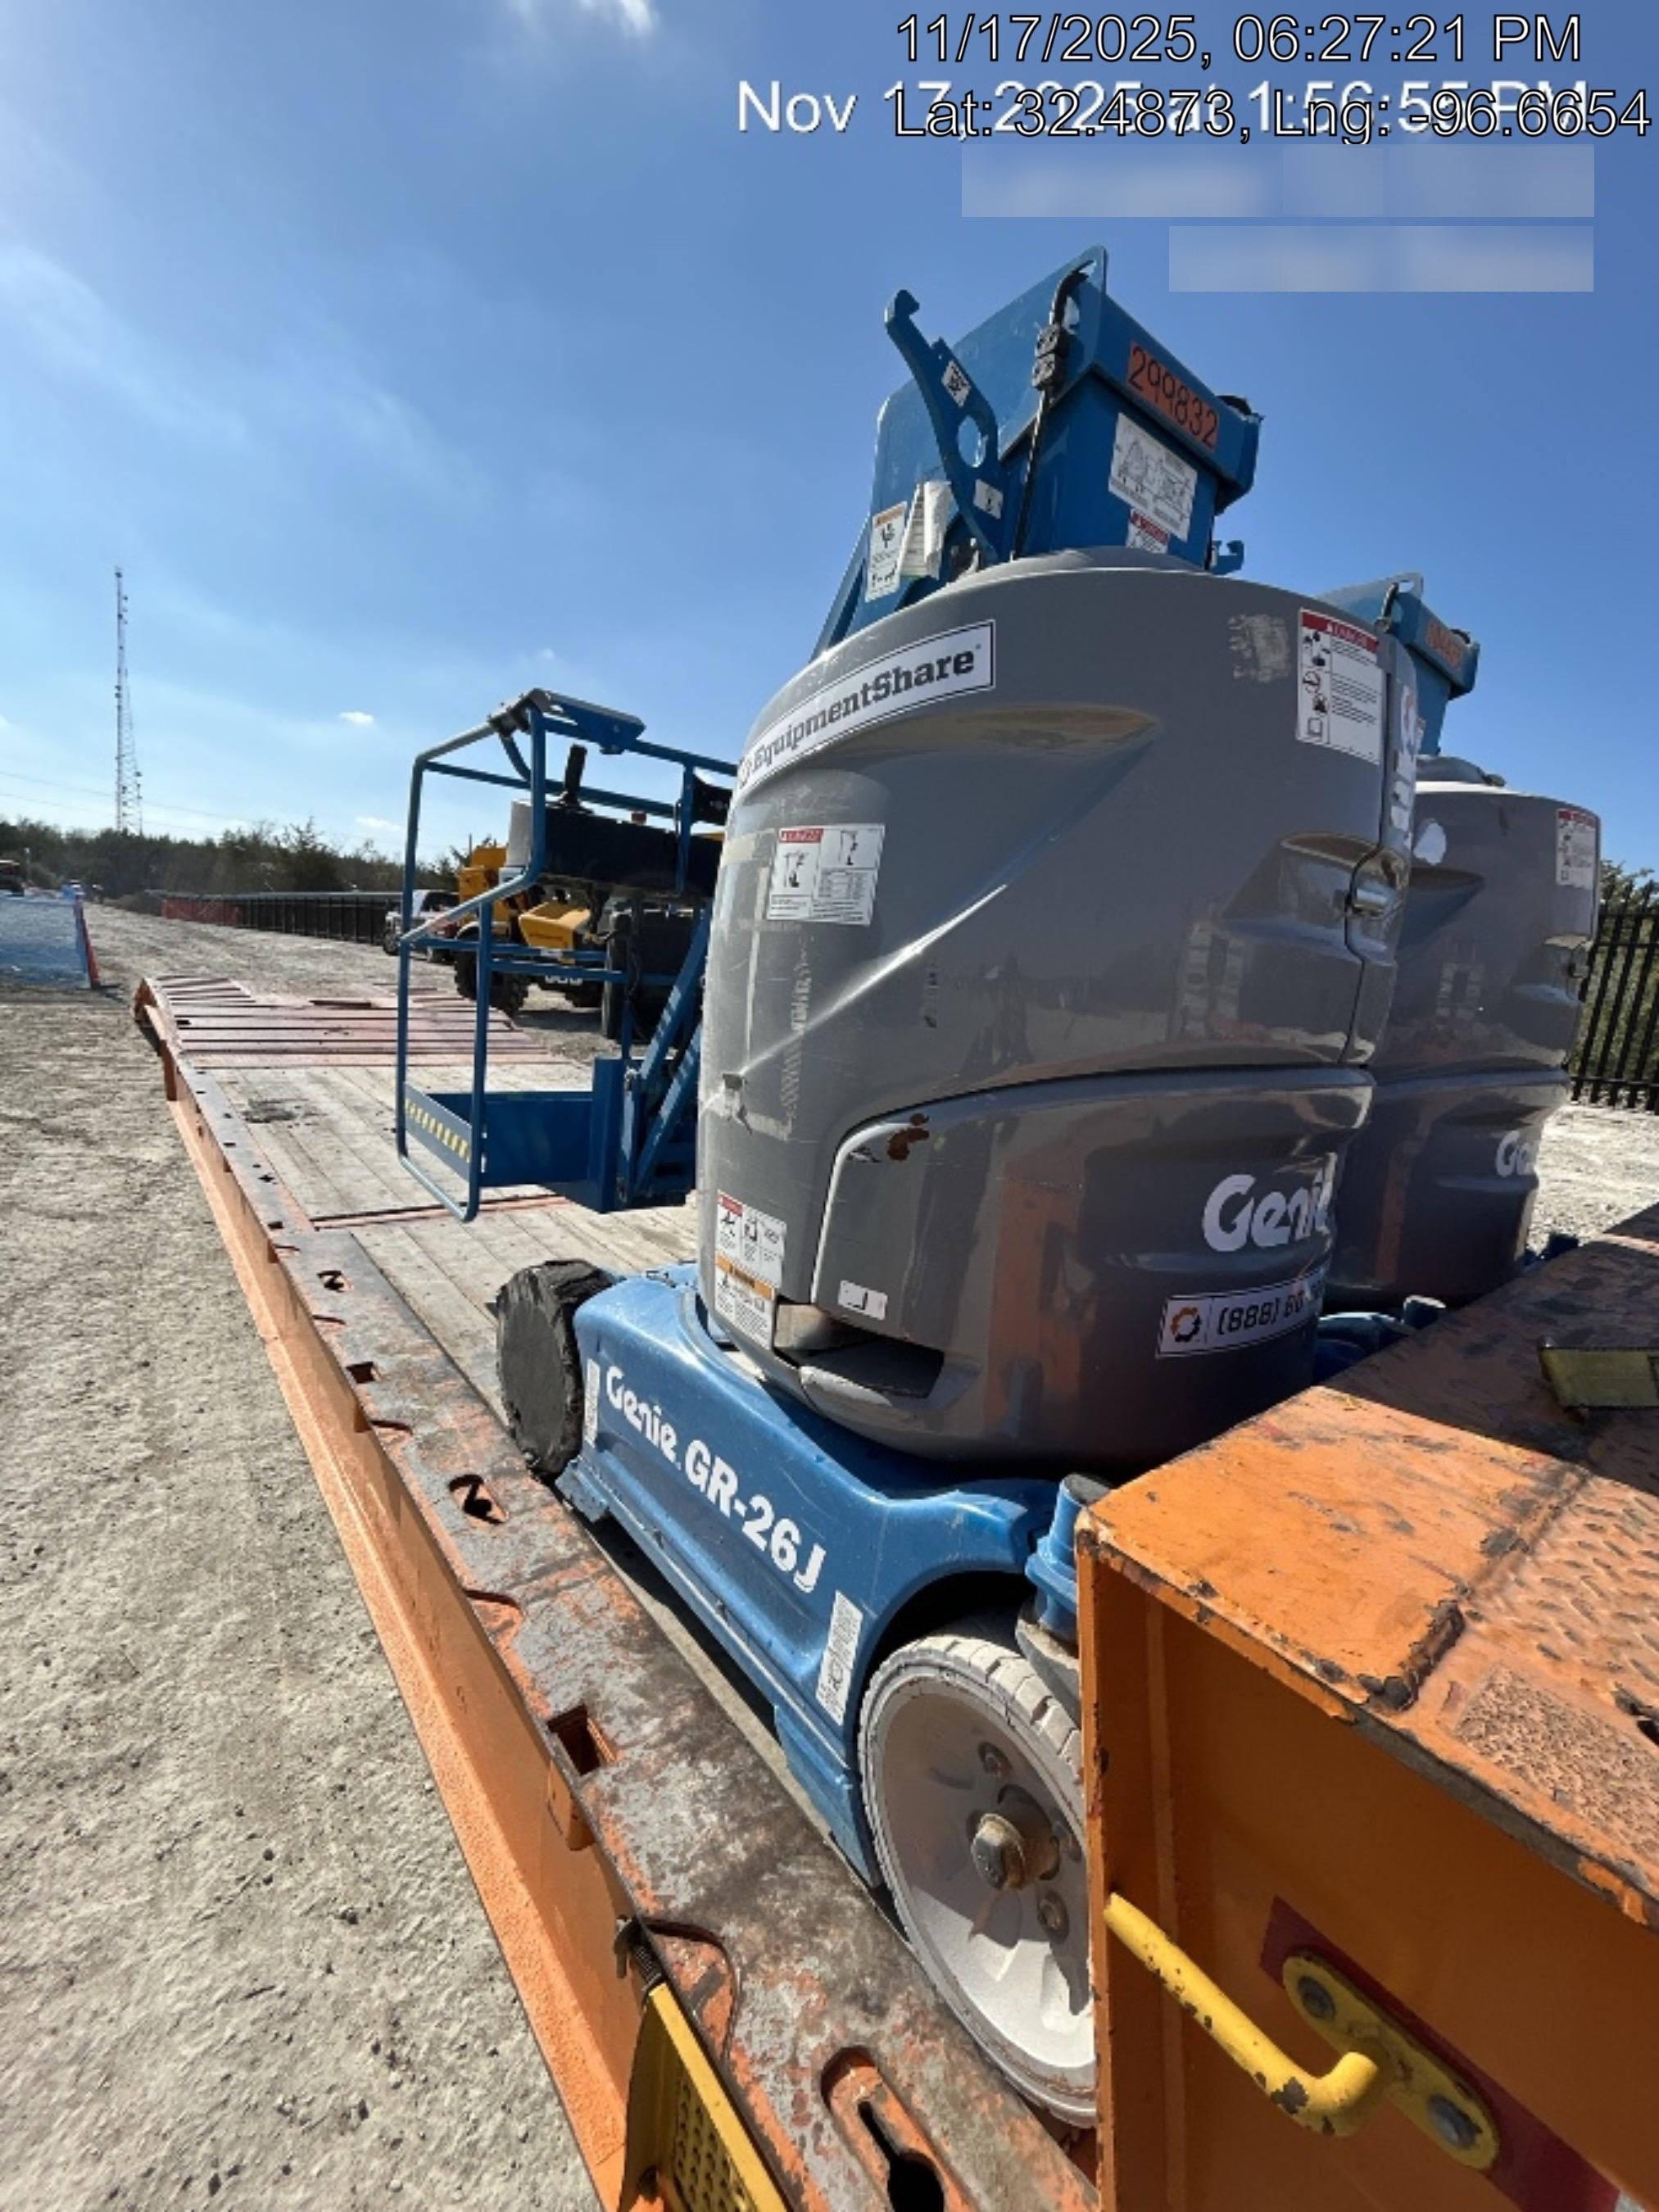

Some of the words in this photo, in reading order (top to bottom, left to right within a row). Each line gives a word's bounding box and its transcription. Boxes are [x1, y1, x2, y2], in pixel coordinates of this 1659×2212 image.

[1128, 346, 1217, 451] 299832
[752, 649, 975, 770] EquipmentShare
[1217, 1297, 1281, 1335] (888)
[605, 1366, 678, 1465] Genie
[684, 1439, 827, 1593] GR-26J
